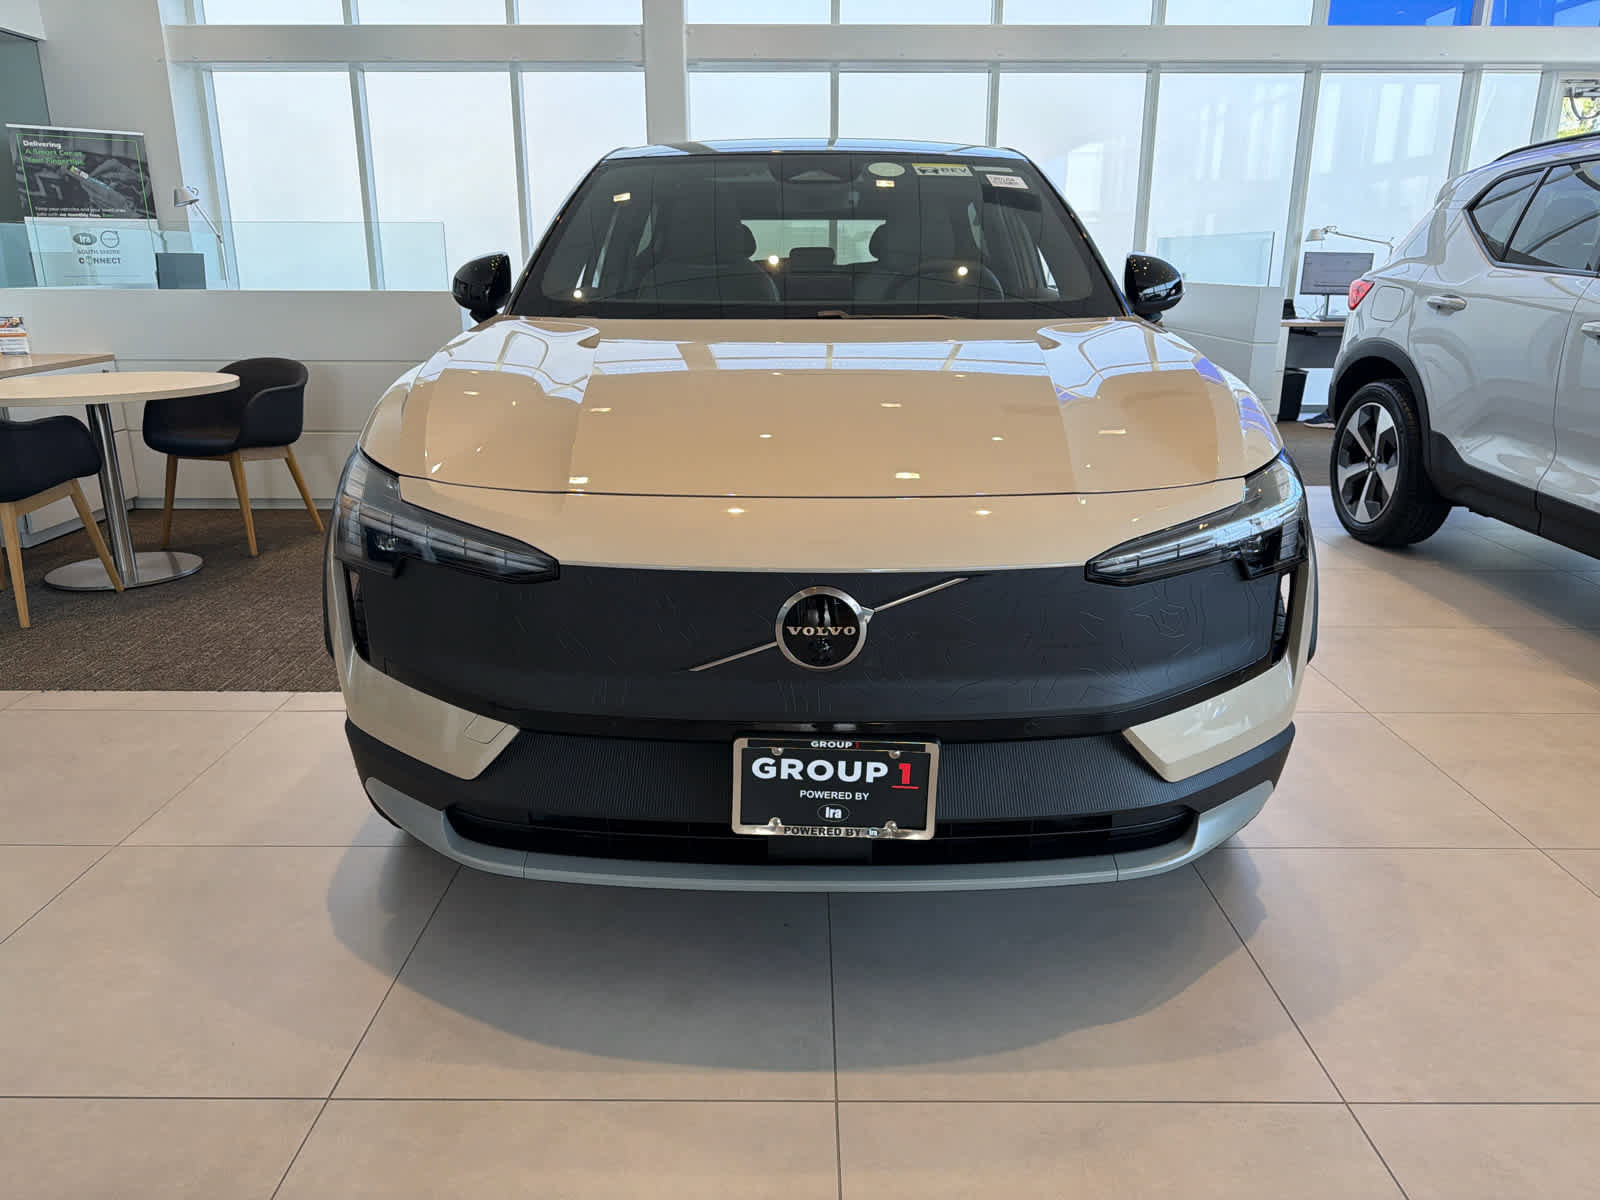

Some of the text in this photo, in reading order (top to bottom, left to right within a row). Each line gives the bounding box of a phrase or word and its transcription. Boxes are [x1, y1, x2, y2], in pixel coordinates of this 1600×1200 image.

[22, 139, 62, 149] Delivering
[786, 626, 856, 636] VOLVO
[810, 740, 860, 749] GROUP 1
[751, 757, 912, 785] GROUP 1
[799, 790, 870, 801] POWERED BY
[825, 806, 842, 819] Ira
[783, 826, 842, 836] POWERED
[846, 827, 861, 837] BY
